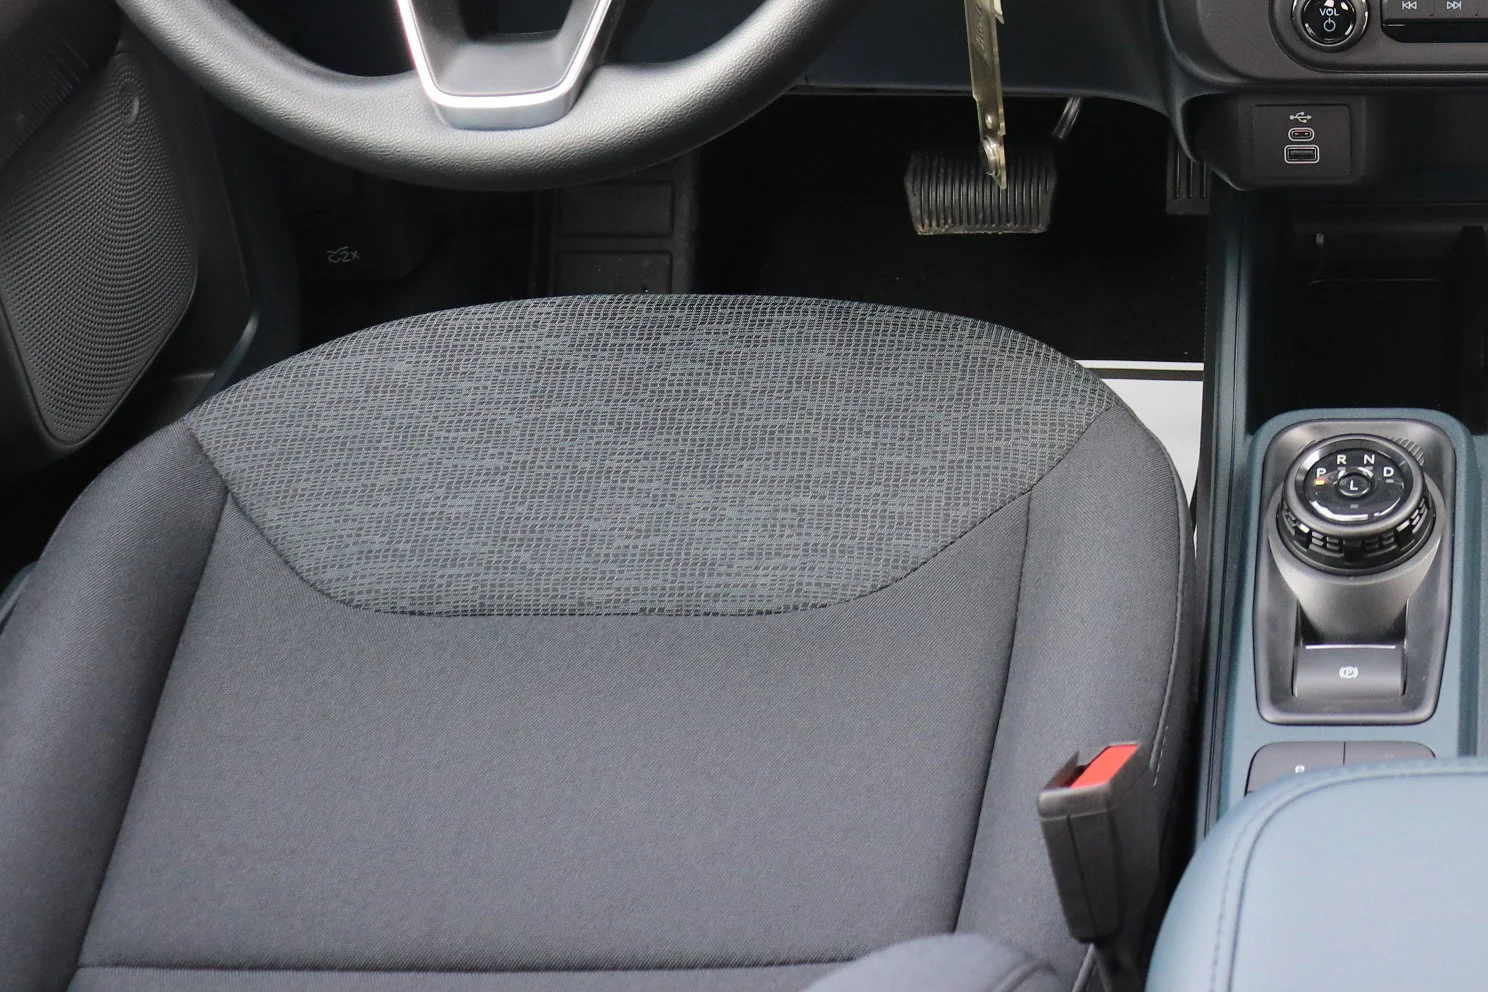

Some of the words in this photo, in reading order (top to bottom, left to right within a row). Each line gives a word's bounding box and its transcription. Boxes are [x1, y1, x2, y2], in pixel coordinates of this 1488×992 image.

[1319, 7, 1340, 17] VOL
[1316, 467, 1327, 479] P
[1337, 454, 1347, 465] R
[1364, 454, 1375, 465] N
[1383, 467, 1394, 478] D
[1350, 481, 1359, 490] L
